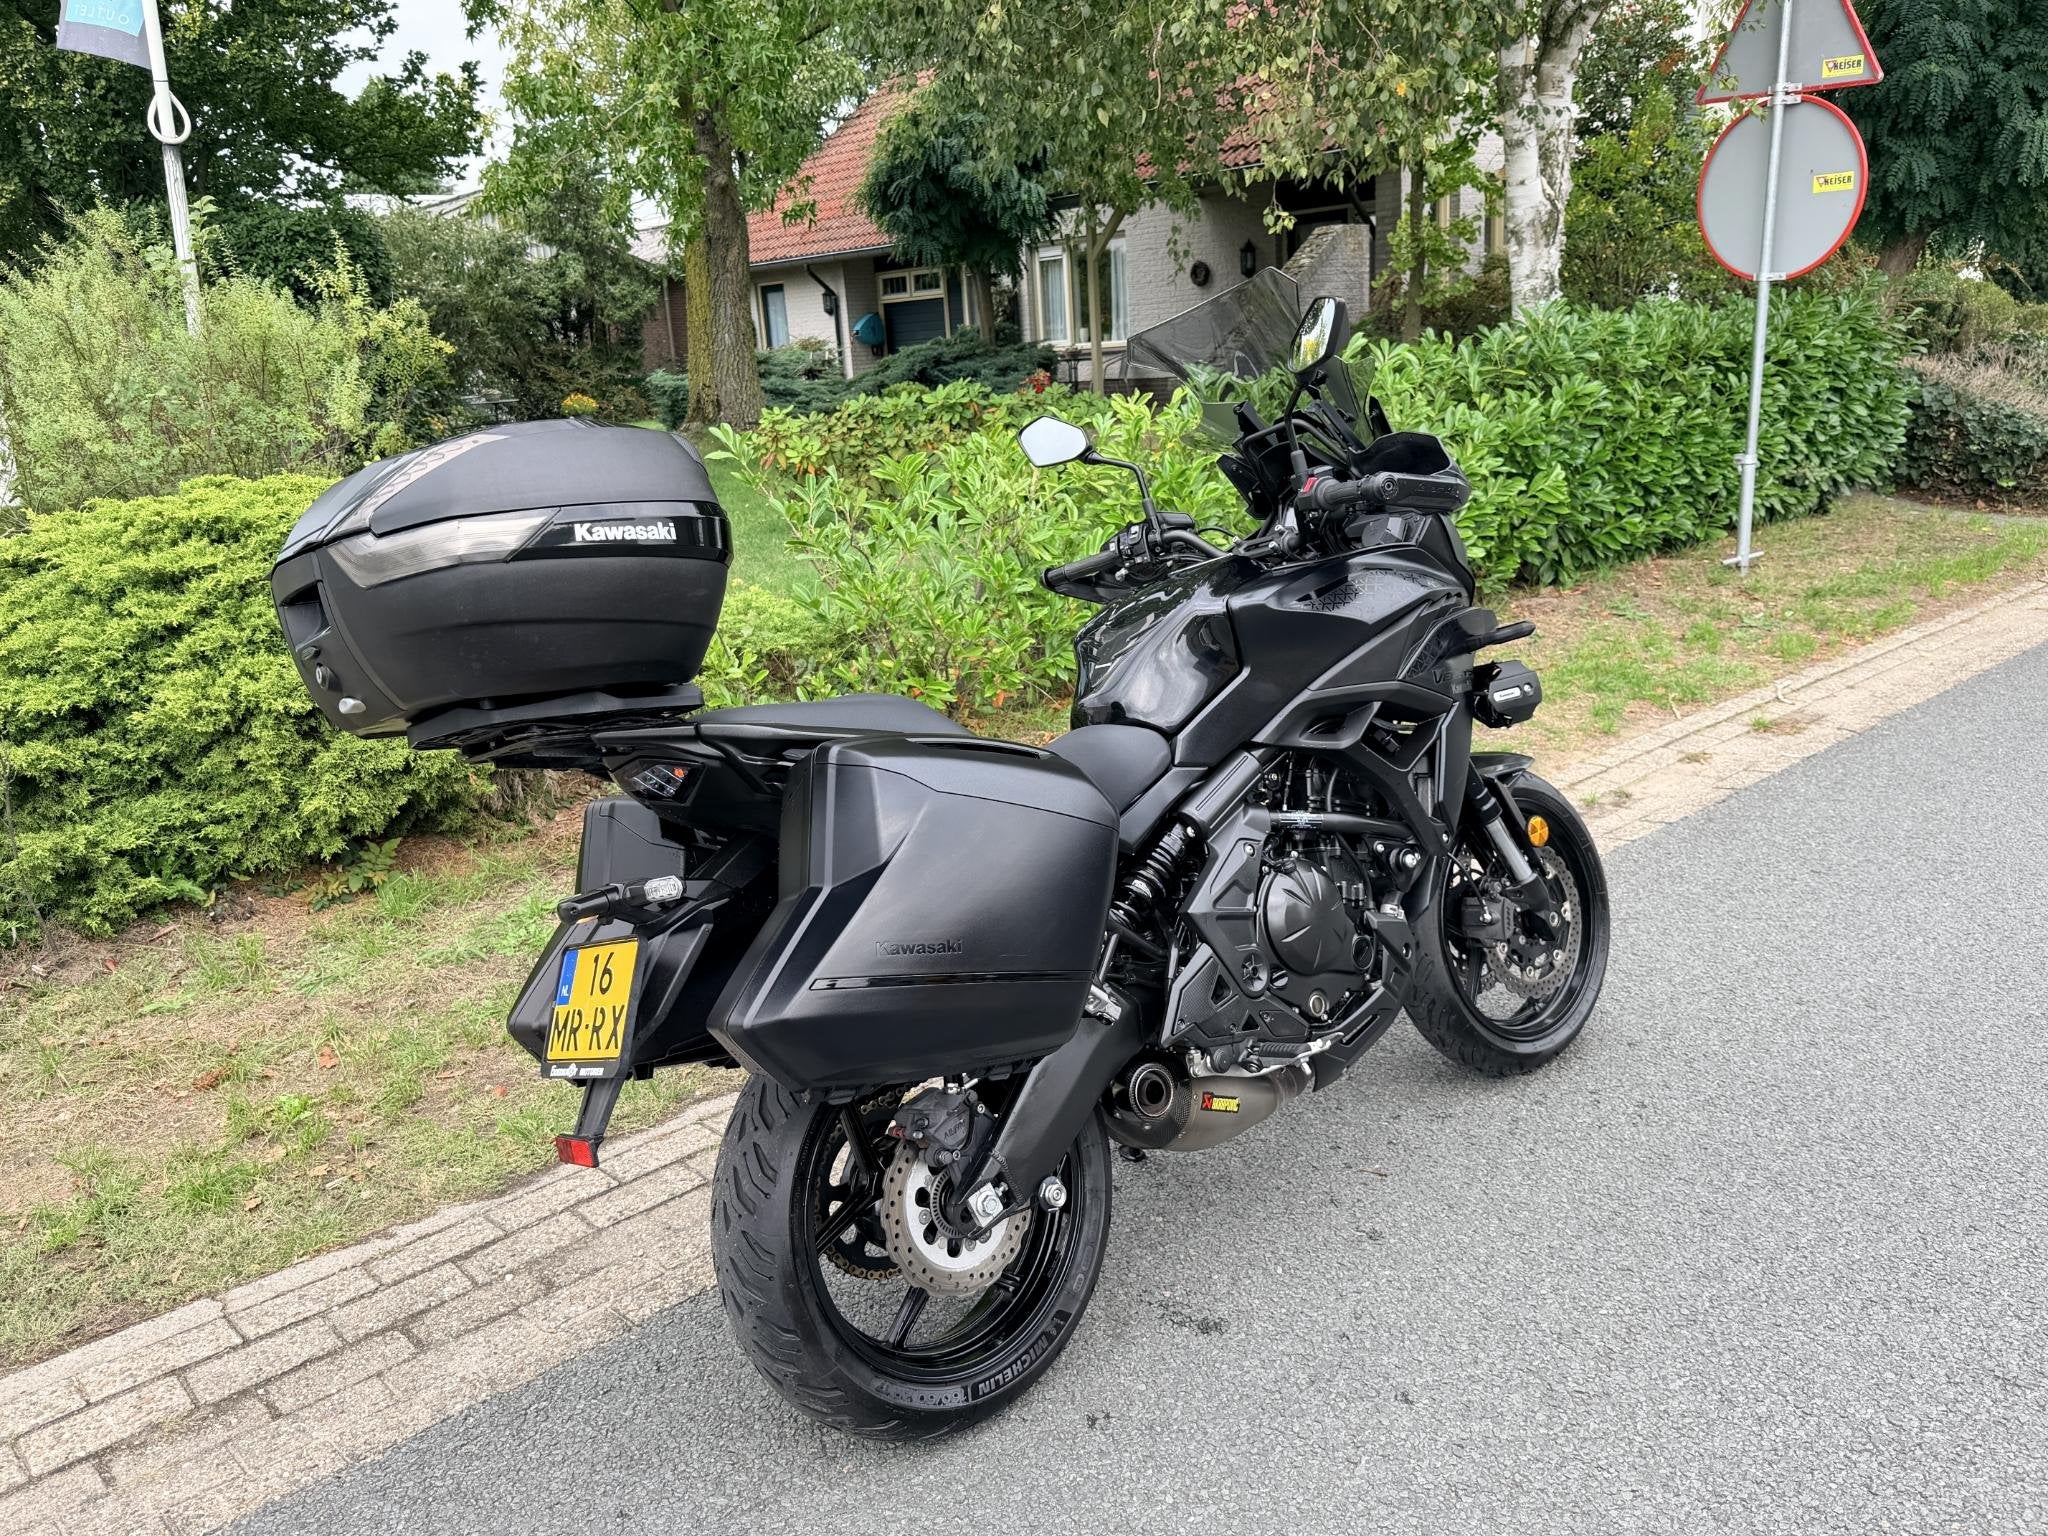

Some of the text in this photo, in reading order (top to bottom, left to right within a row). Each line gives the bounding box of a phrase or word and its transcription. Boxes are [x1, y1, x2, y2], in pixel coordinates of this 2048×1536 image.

[574, 522, 677, 541] Kawasaki
[874, 940, 963, 956] Kawasaki
[589, 952, 614, 996] 16
[561, 985, 569, 997] NL
[978, 1335, 1049, 1396] MICHELIN
